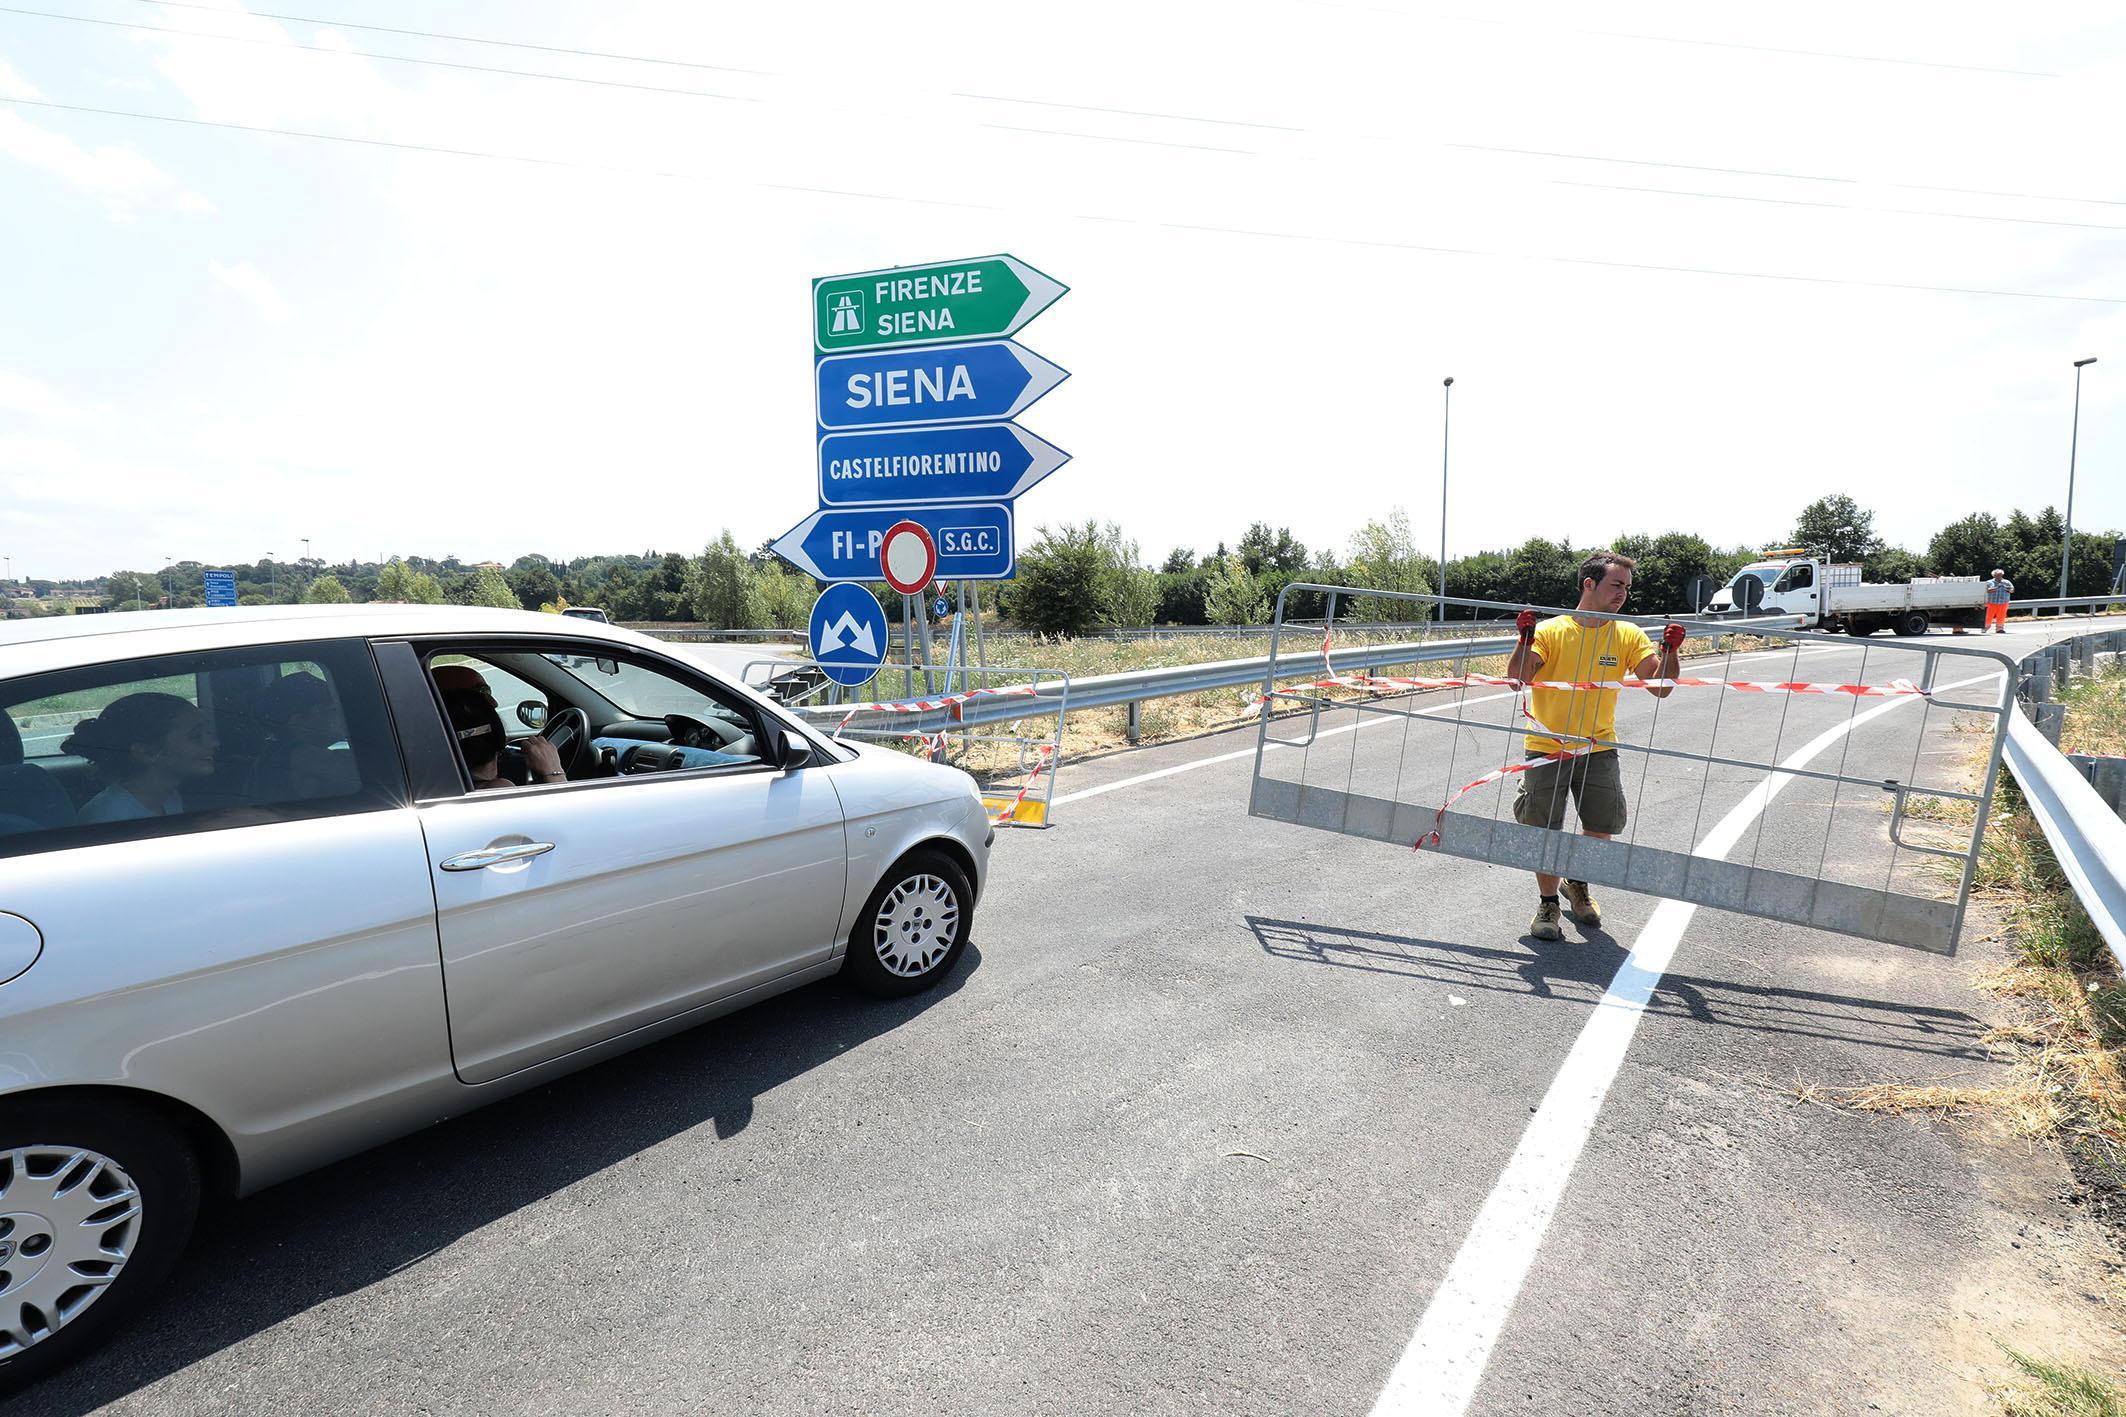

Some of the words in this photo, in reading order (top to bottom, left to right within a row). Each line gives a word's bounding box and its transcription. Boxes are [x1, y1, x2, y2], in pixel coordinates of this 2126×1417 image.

[875, 270, 983, 304] FIRENZE
[877, 307, 956, 336] SIENA
[845, 364, 977, 409] SIENA
[829, 450, 1001, 480] CASTELFIORENTINO
[832, 529, 888, 560] FI-P
[945, 531, 994, 552] S.G.C.
